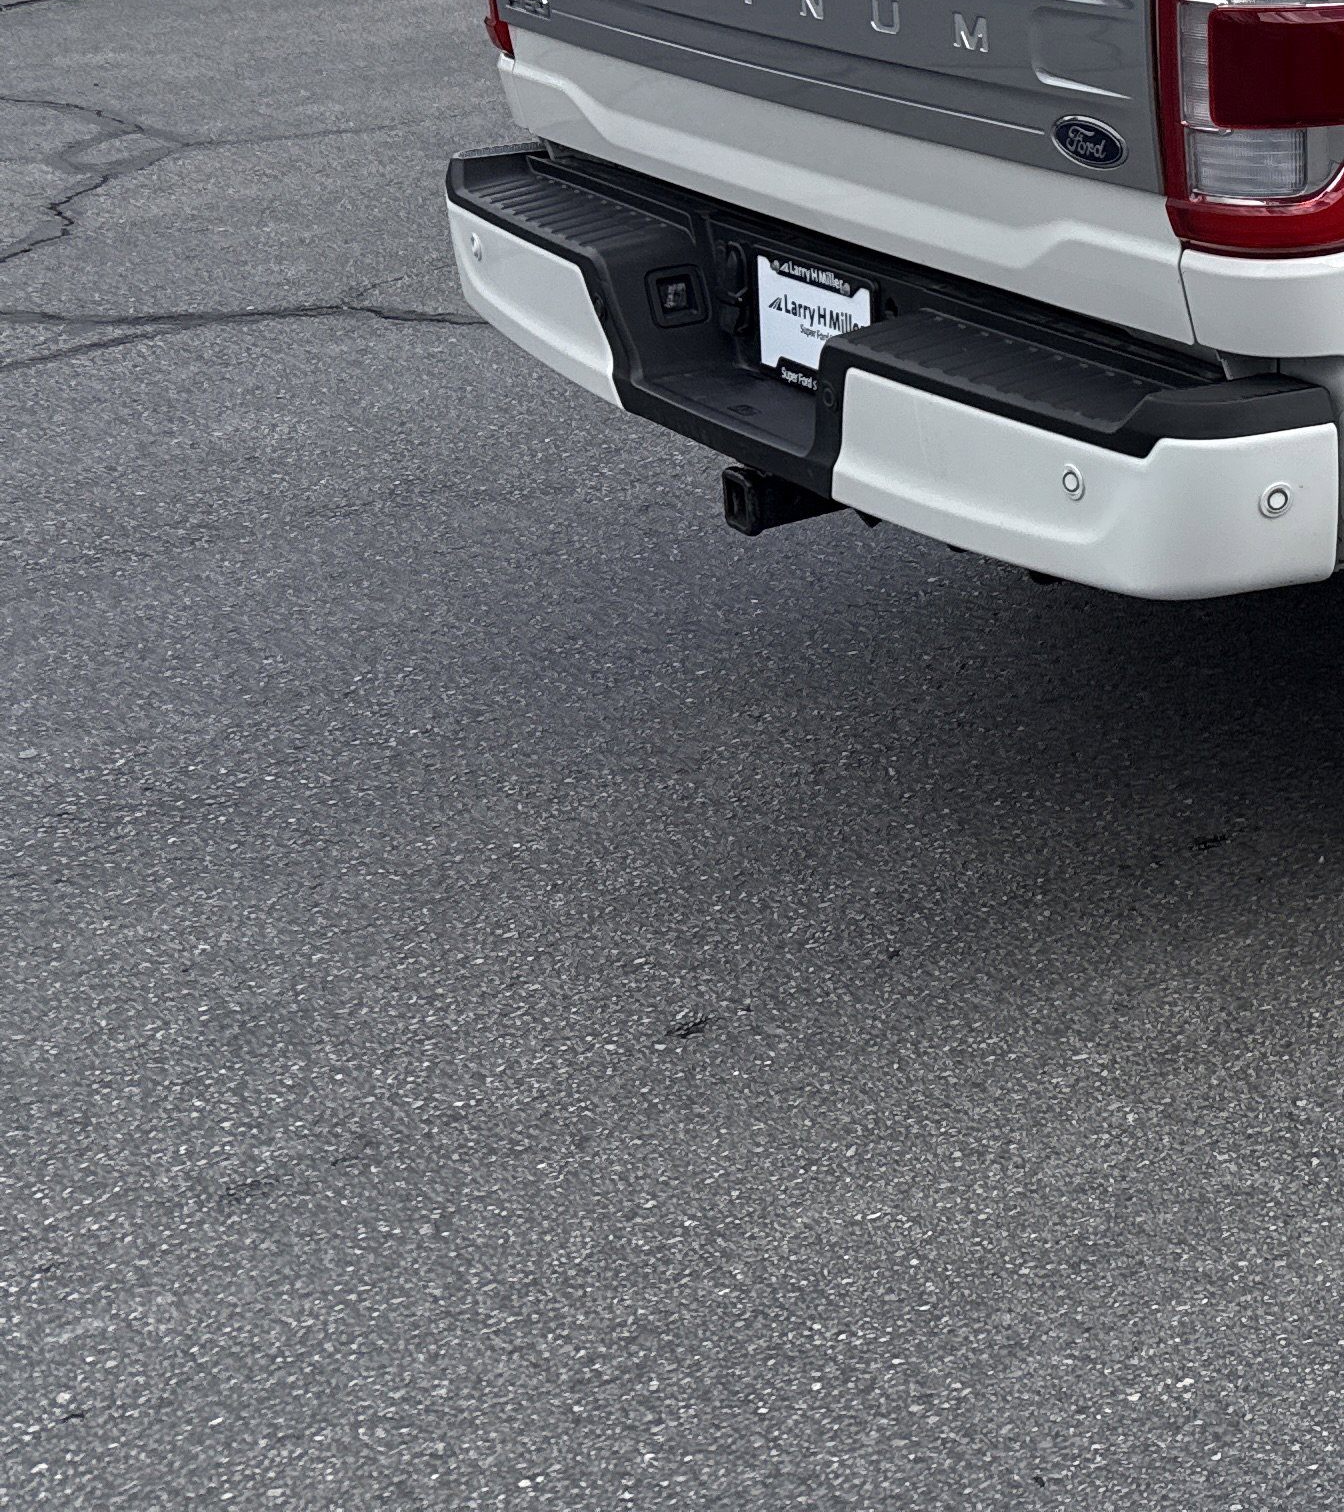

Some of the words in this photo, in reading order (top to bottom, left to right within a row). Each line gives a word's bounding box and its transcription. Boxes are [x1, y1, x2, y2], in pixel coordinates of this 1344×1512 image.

[1065, 125, 1107, 159] Ford
[784, 294, 815, 327] Larry
[817, 305, 827, 327] H
